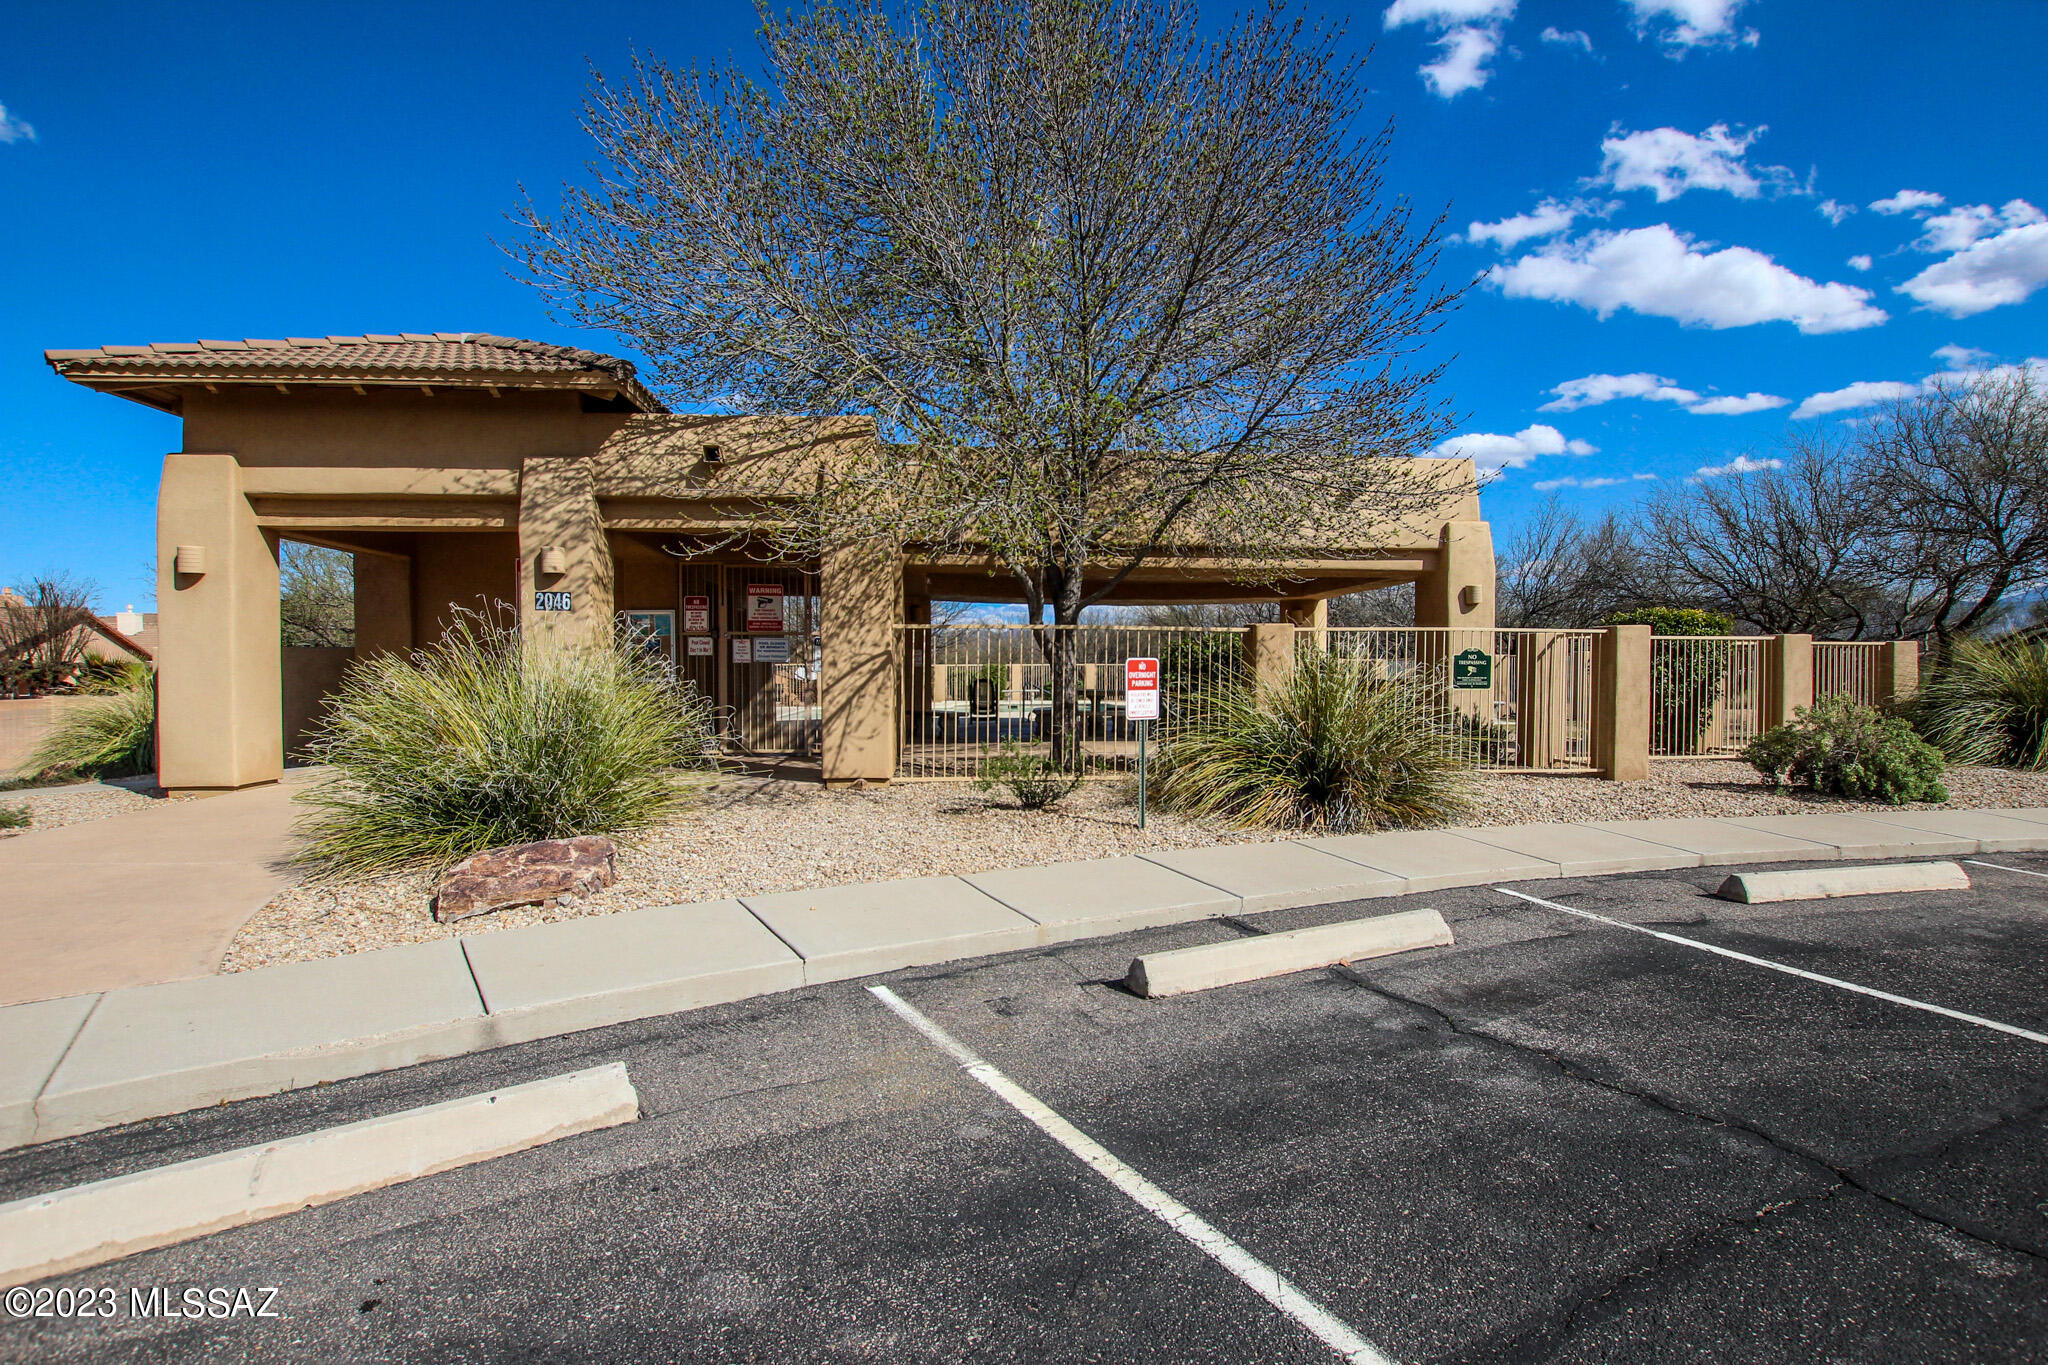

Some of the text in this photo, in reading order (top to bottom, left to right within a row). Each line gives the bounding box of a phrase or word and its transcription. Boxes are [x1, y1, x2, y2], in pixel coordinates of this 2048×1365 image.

[535, 592, 571, 610] 2046
[1138, 661, 1147, 671] NO
[1128, 671, 1157, 679] OVERNIGHT
[1131, 679, 1154, 687] PARKING
